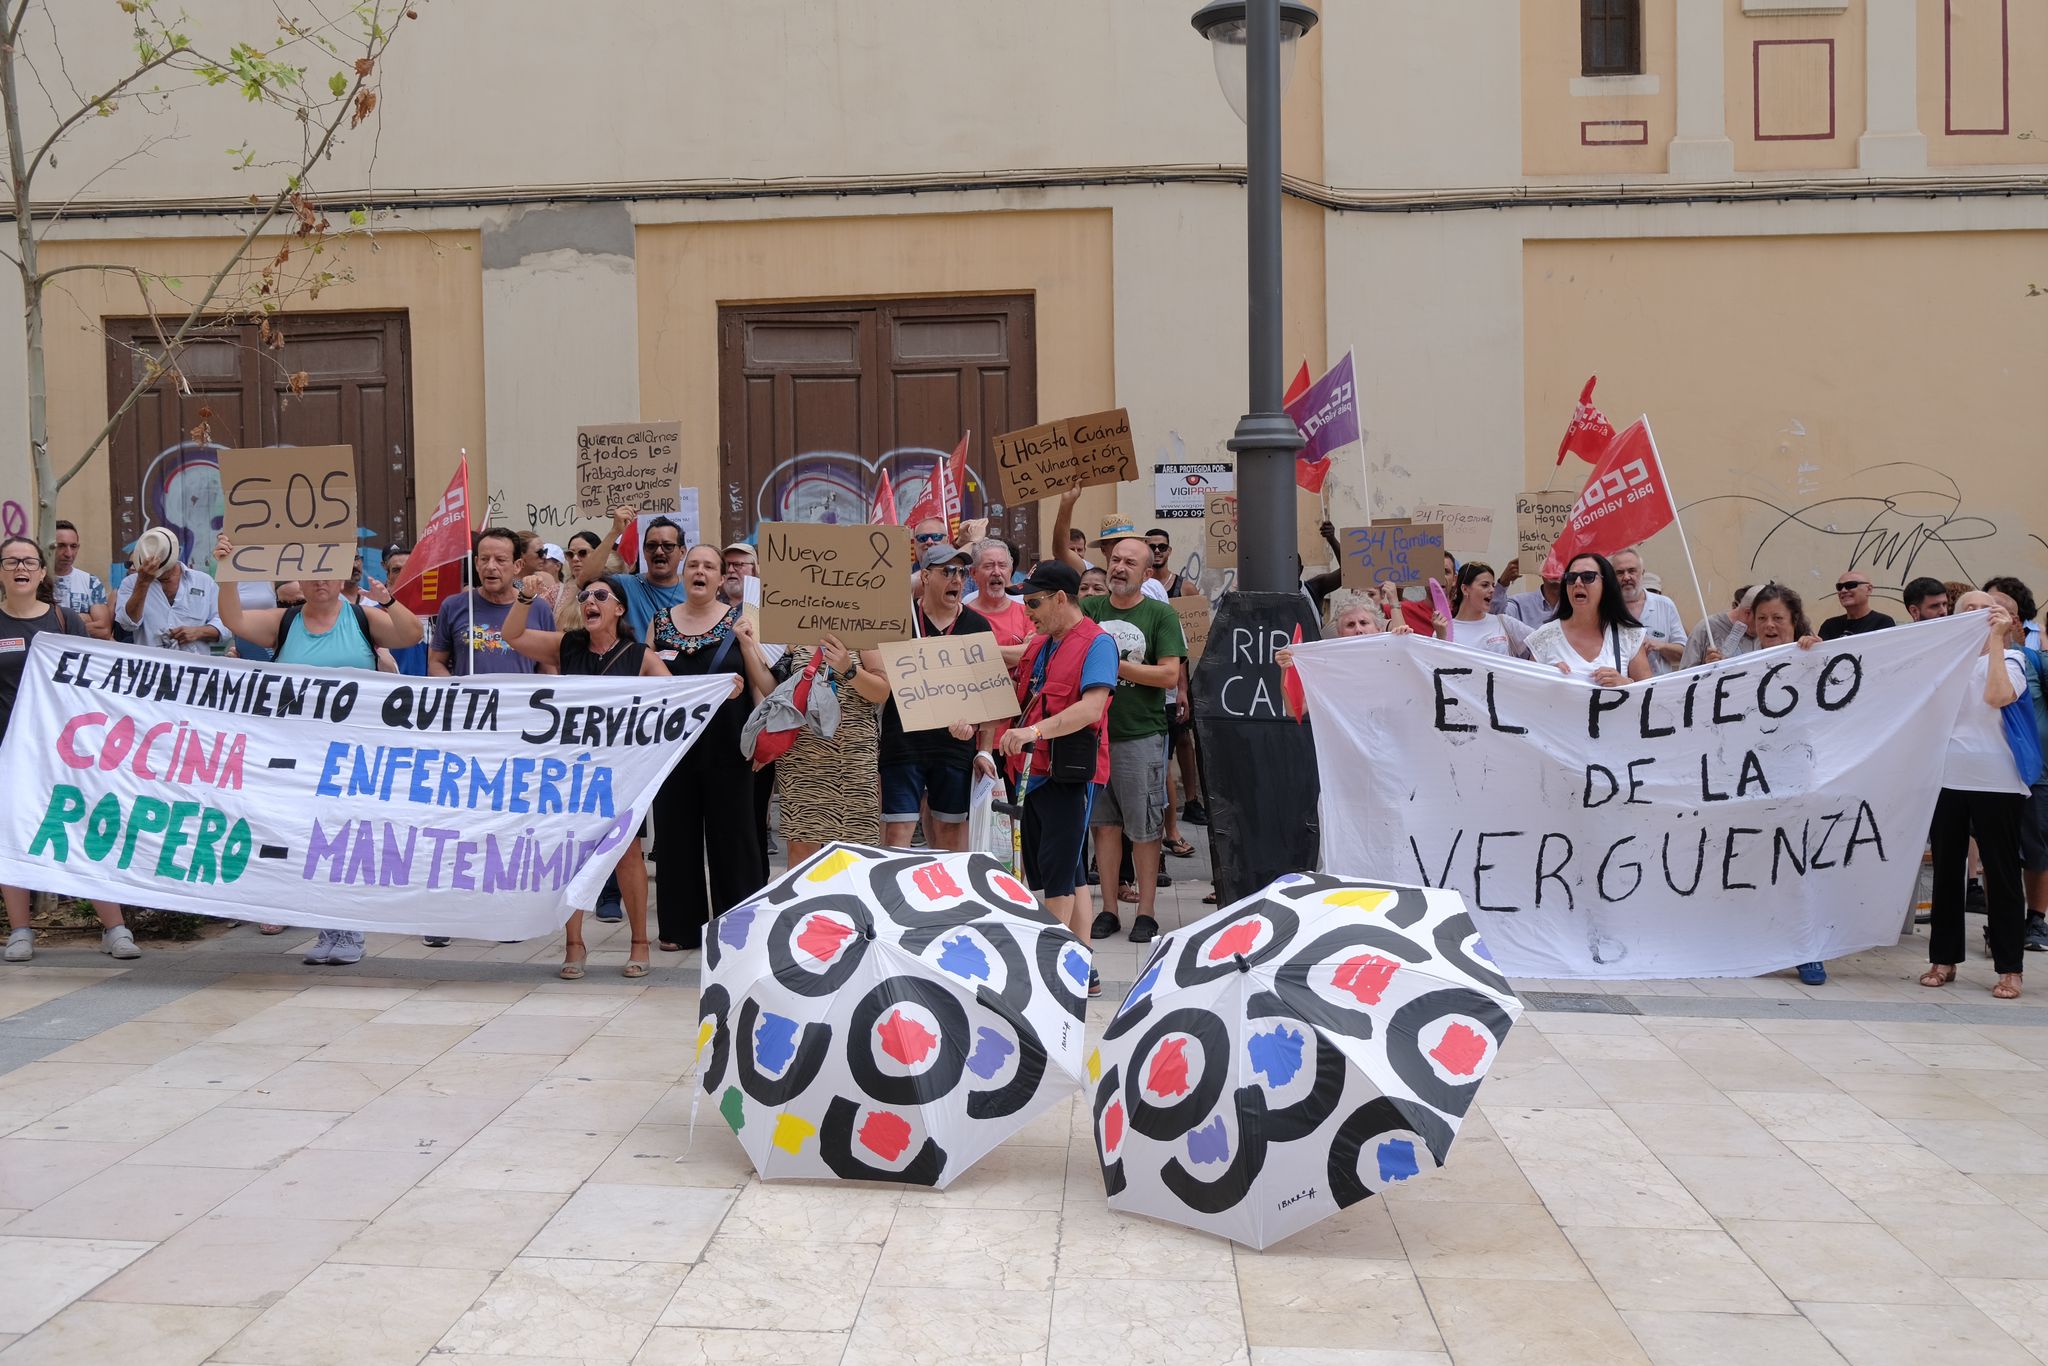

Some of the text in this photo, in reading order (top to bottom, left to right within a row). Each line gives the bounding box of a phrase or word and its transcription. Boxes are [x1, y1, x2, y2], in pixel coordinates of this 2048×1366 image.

[577, 433, 623, 449] Quieren
[1000, 418, 1128, 468] ¿Hasta Cuándo
[593, 446, 638, 463] todos
[577, 462, 678, 482] Trabajadores del
[1011, 471, 1032, 485] La
[1180, 464, 1211, 473] PROTEGIDA
[229, 471, 350, 533] S.O.S
[582, 491, 650, 508] nos haremos
[1018, 487, 1039, 498] De
[606, 498, 676, 518] EUCHAR
[1173, 510, 1188, 518] 902
[1348, 529, 1386, 557] 34
[1520, 529, 1550, 542] Hasta
[768, 533, 837, 562] Nuevo
[1218, 539, 1237, 554] RO
[232, 542, 340, 576] CAI
[1362, 551, 1408, 567] a la
[801, 564, 885, 590] PLIEGO
[798, 615, 906, 634] LAMENTABLES!
[938, 650, 952, 667] A
[52, 651, 91, 688] EL
[1434, 668, 1529, 735] EL
[316, 741, 615, 818] ENFERMERÍA
[1583, 750, 1771, 808] DE LA
[1410, 800, 1888, 913] VERGÜENZA
